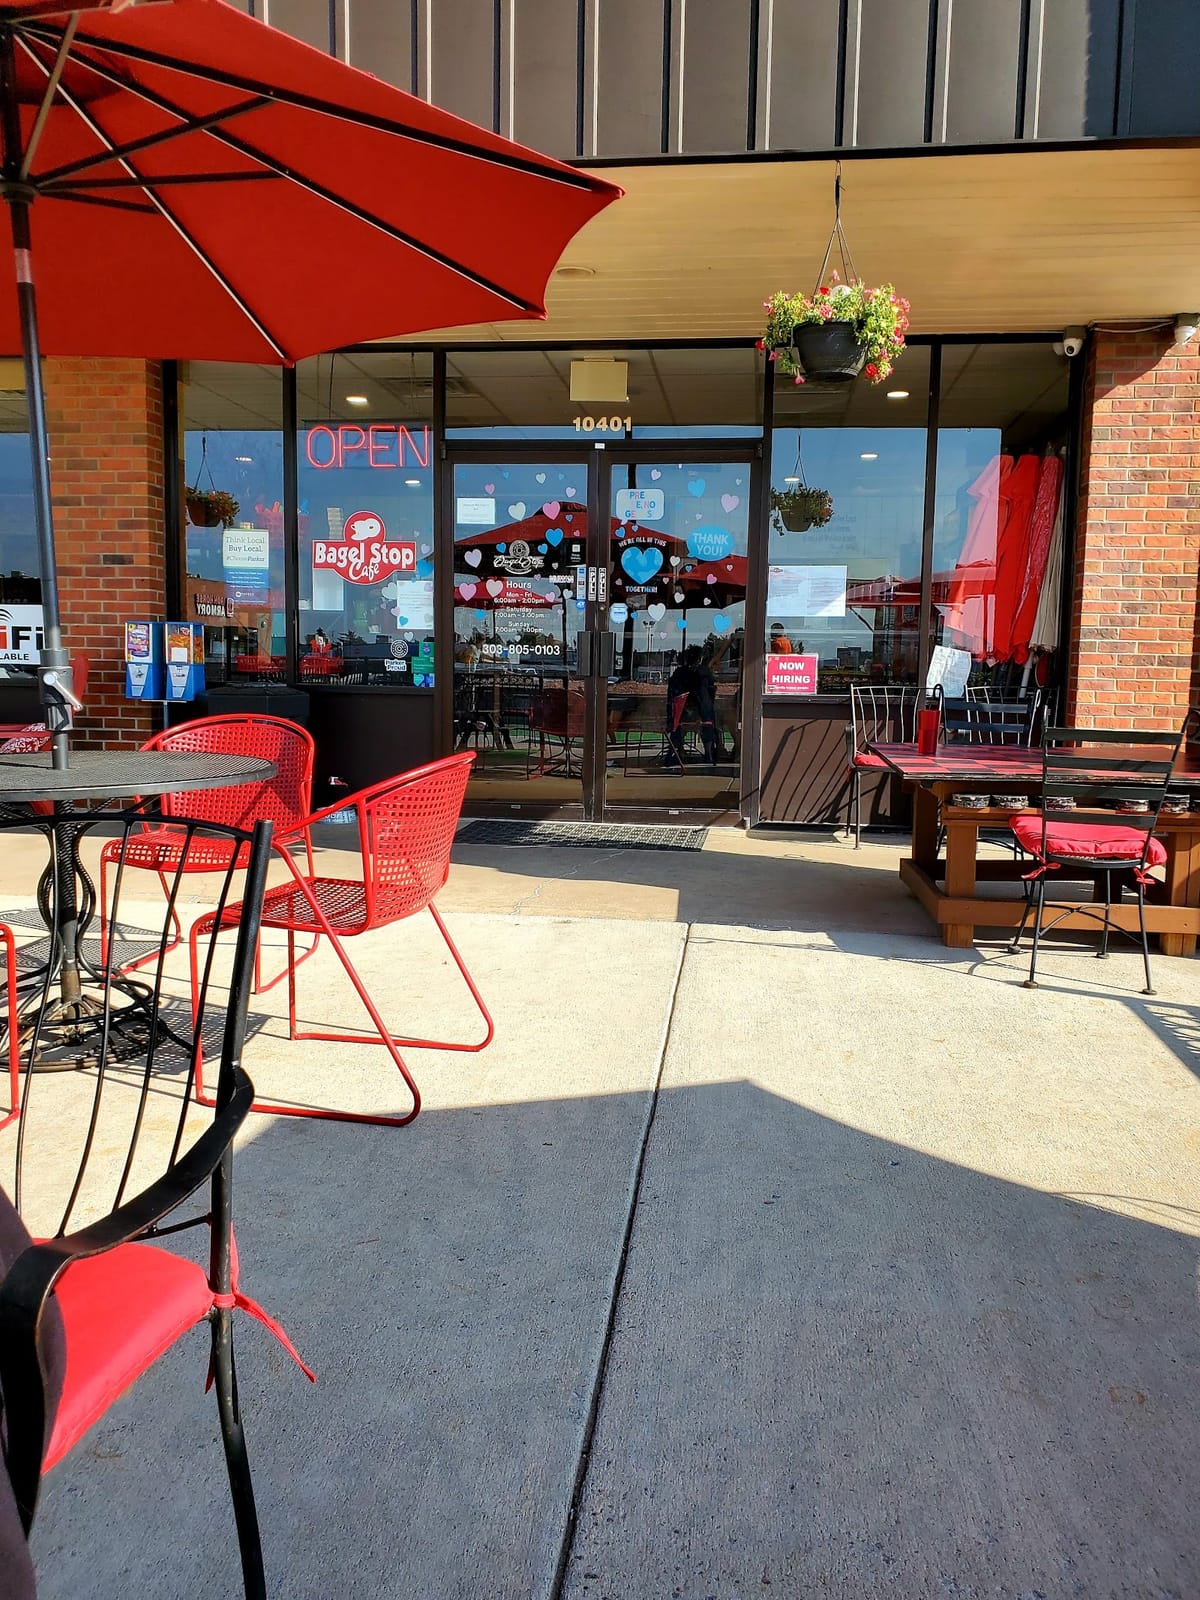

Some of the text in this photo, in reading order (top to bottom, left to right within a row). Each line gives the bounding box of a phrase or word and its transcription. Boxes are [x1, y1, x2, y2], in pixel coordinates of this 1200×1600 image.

[573, 416, 632, 432] 10401
[306, 424, 430, 468] OPEN
[654, 537, 667, 547] THIS
[693, 533, 729, 545] THANK
[228, 544, 242, 552] Buy
[696, 545, 723, 556] YOU!
[315, 543, 414, 568] Bagel Stop
[506, 580, 532, 589] Hours
[482, 643, 561, 655] 303-805-0103
[779, 662, 805, 670] NOW
[772, 674, 811, 684] HIRING
